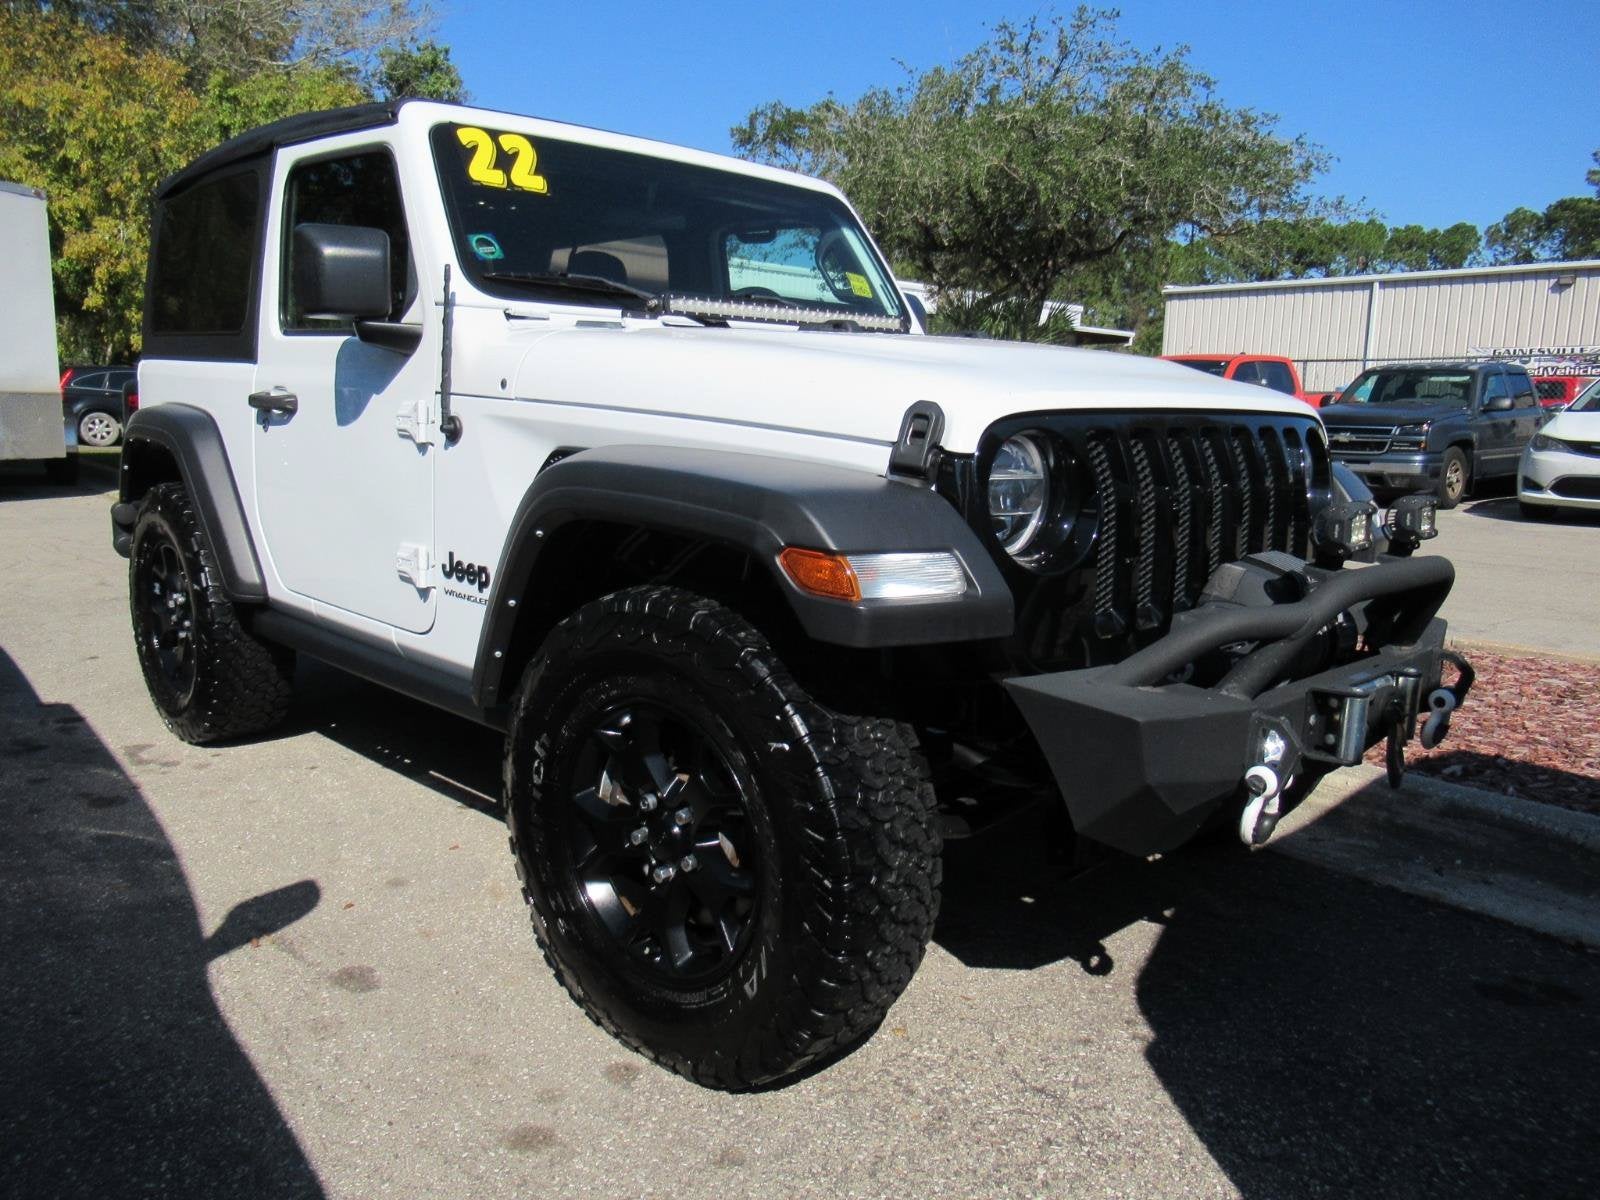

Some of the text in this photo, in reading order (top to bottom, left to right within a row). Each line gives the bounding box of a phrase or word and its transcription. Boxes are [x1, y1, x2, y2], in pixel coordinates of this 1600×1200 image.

[456, 126, 549, 194] 22
[1493, 347, 1587, 356] GAINESVILLE
[441, 551, 490, 593] Jeep
